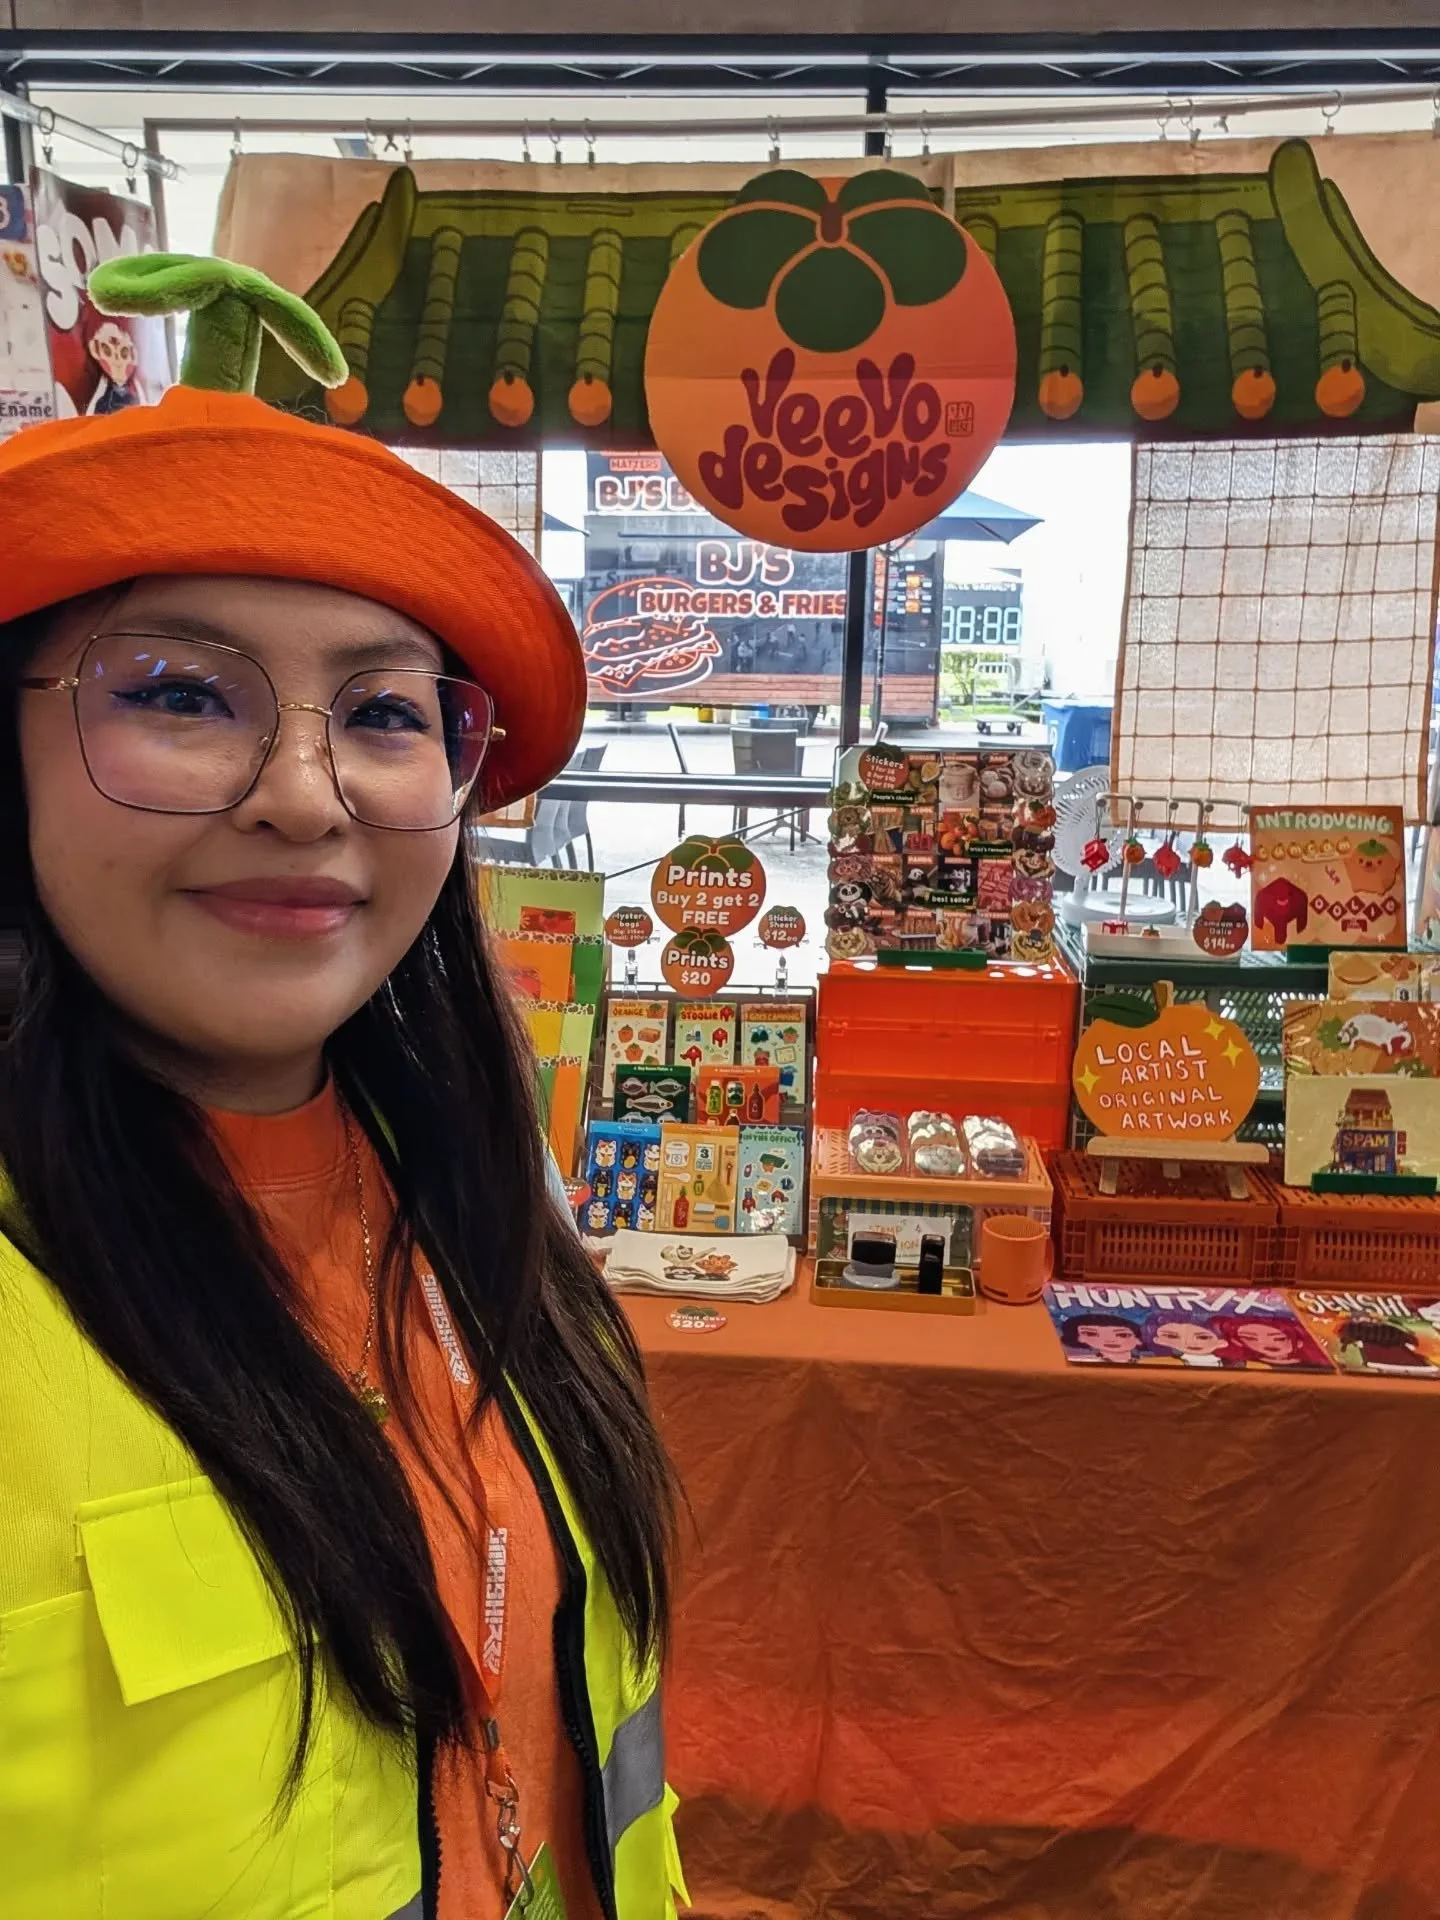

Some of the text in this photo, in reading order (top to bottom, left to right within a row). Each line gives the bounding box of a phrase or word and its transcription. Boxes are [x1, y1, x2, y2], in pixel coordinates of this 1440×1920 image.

[596, 476, 665, 510] BJ'S
[697, 541, 794, 585] BJ'S
[637, 589, 845, 618] BURGERS & FRIES
[865, 754, 904, 770] Stickers
[668, 865, 752, 888] Prints
[657, 890, 760, 909] Buy 2 get 2
[619, 921, 640, 929] bags
[682, 910, 730, 925] FREE
[769, 921, 797, 929] Sheets
[667, 950, 728, 969] Prints
[681, 971, 711, 986] $20
[1096, 1035, 1202, 1065] LOCAL
[1120, 1060, 1208, 1086] ARTIST
[1099, 1085, 1223, 1109] ORIGINAL
[1121, 1108, 1233, 1130] ARTWORK
[1342, 1133, 1390, 1148] SPAM
[700, 1148, 709, 1158] 3
[1299, 1292, 1411, 1316] SENSHI
